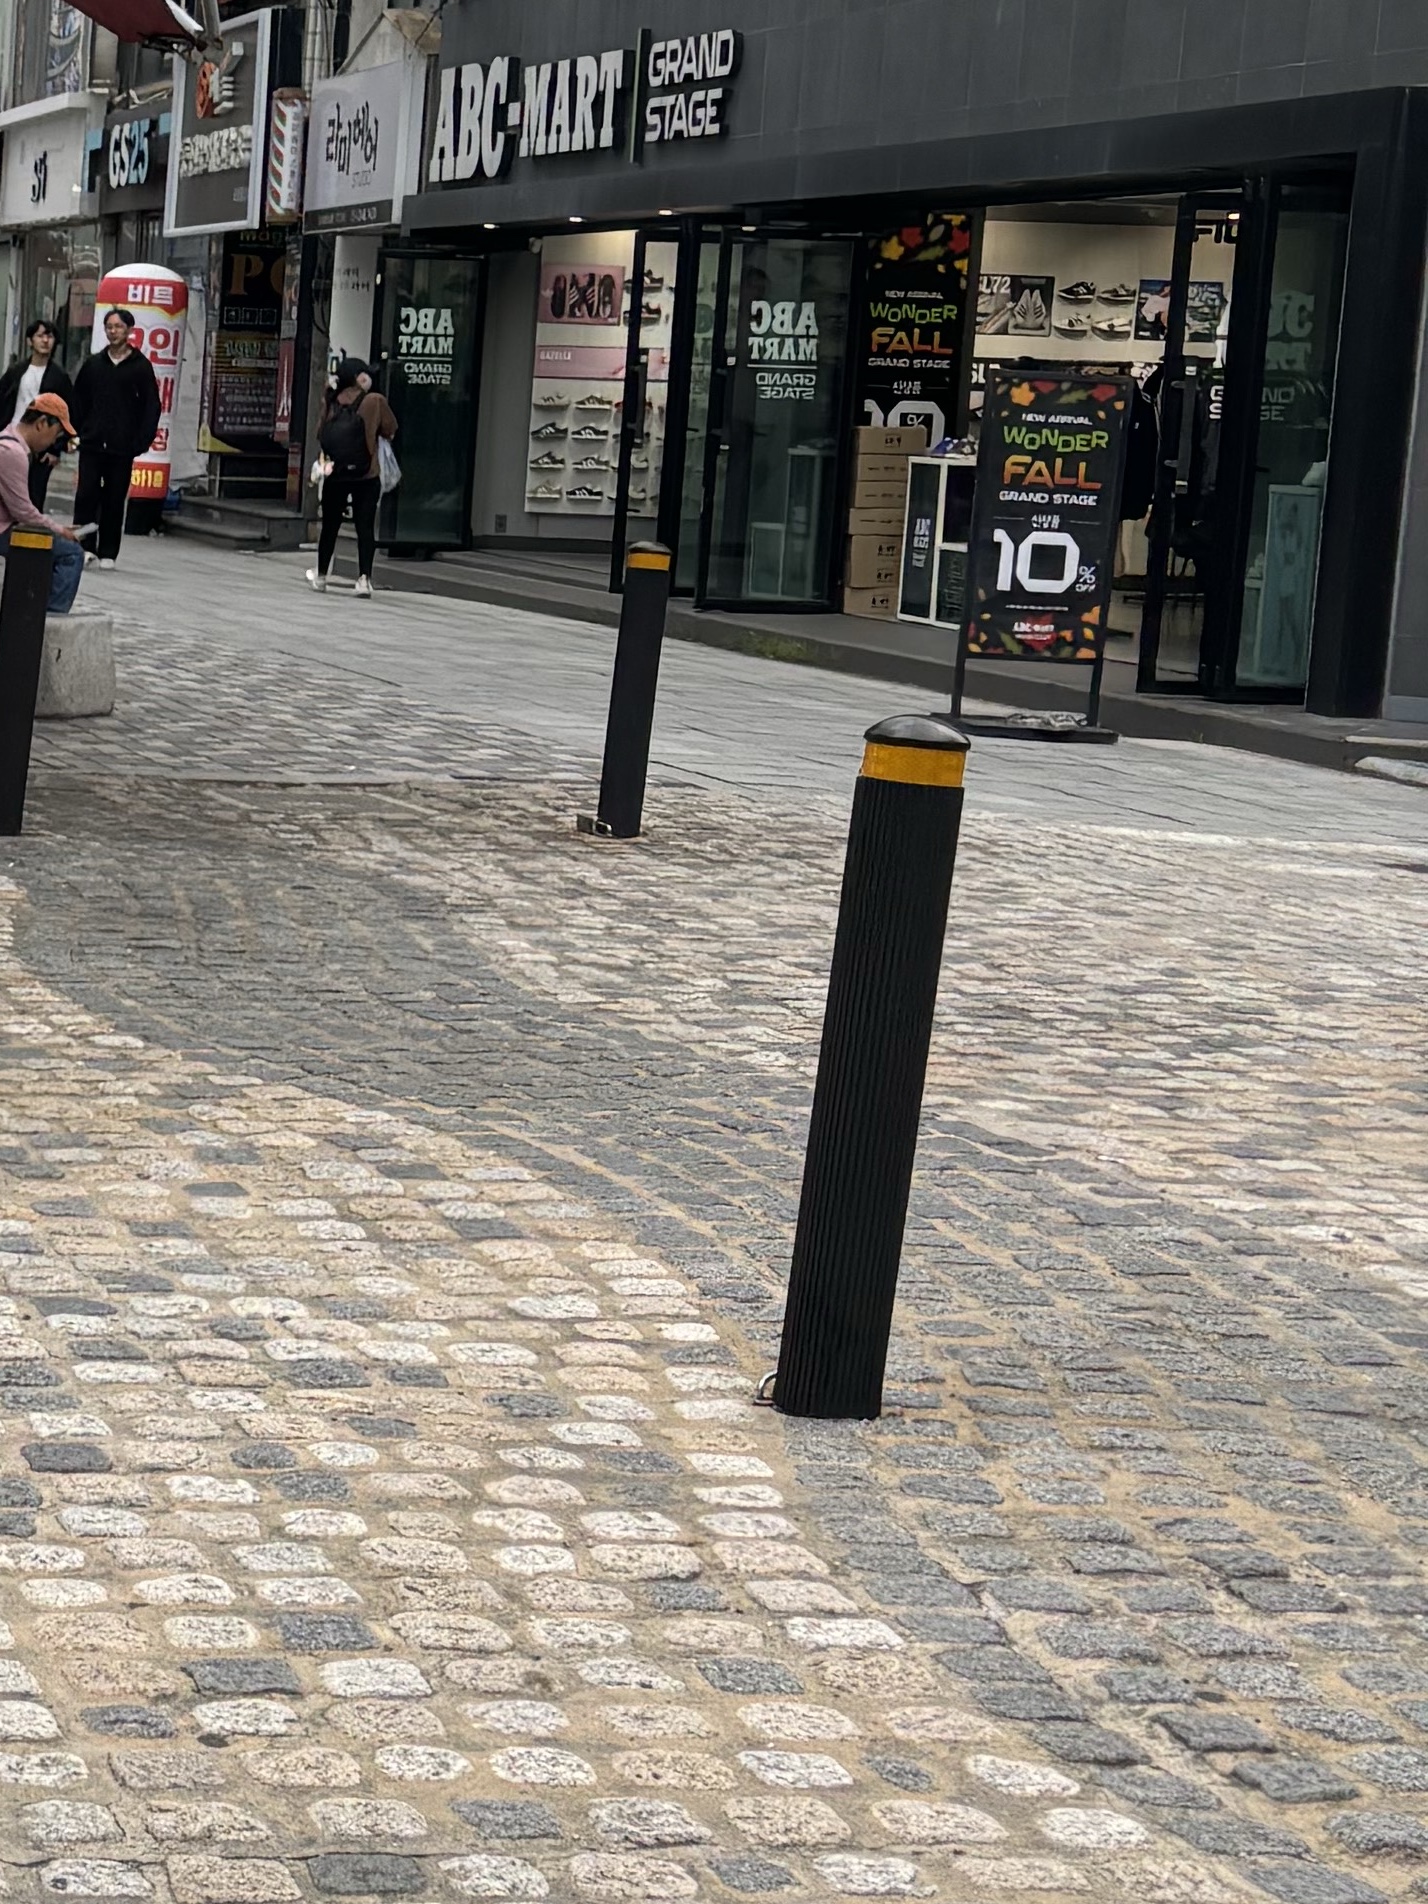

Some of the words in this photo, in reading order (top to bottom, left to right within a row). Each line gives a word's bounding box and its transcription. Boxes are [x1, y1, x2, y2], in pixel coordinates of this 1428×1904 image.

[648, 28, 734, 87] GRAND
[429, 49, 623, 183] ABC-MART
[644, 88, 722, 142] STAGE
[108, 118, 151, 189] GS25
[127, 284, 174, 306] 비트
[870, 302, 958, 324] WONDER
[871, 327, 953, 354] FALL
[1003, 426, 1109, 453] WONDER
[1003, 454, 1102, 489] FALL
[999, 491, 1049, 504] GRAND
[1053, 492, 1097, 506] STAGE
